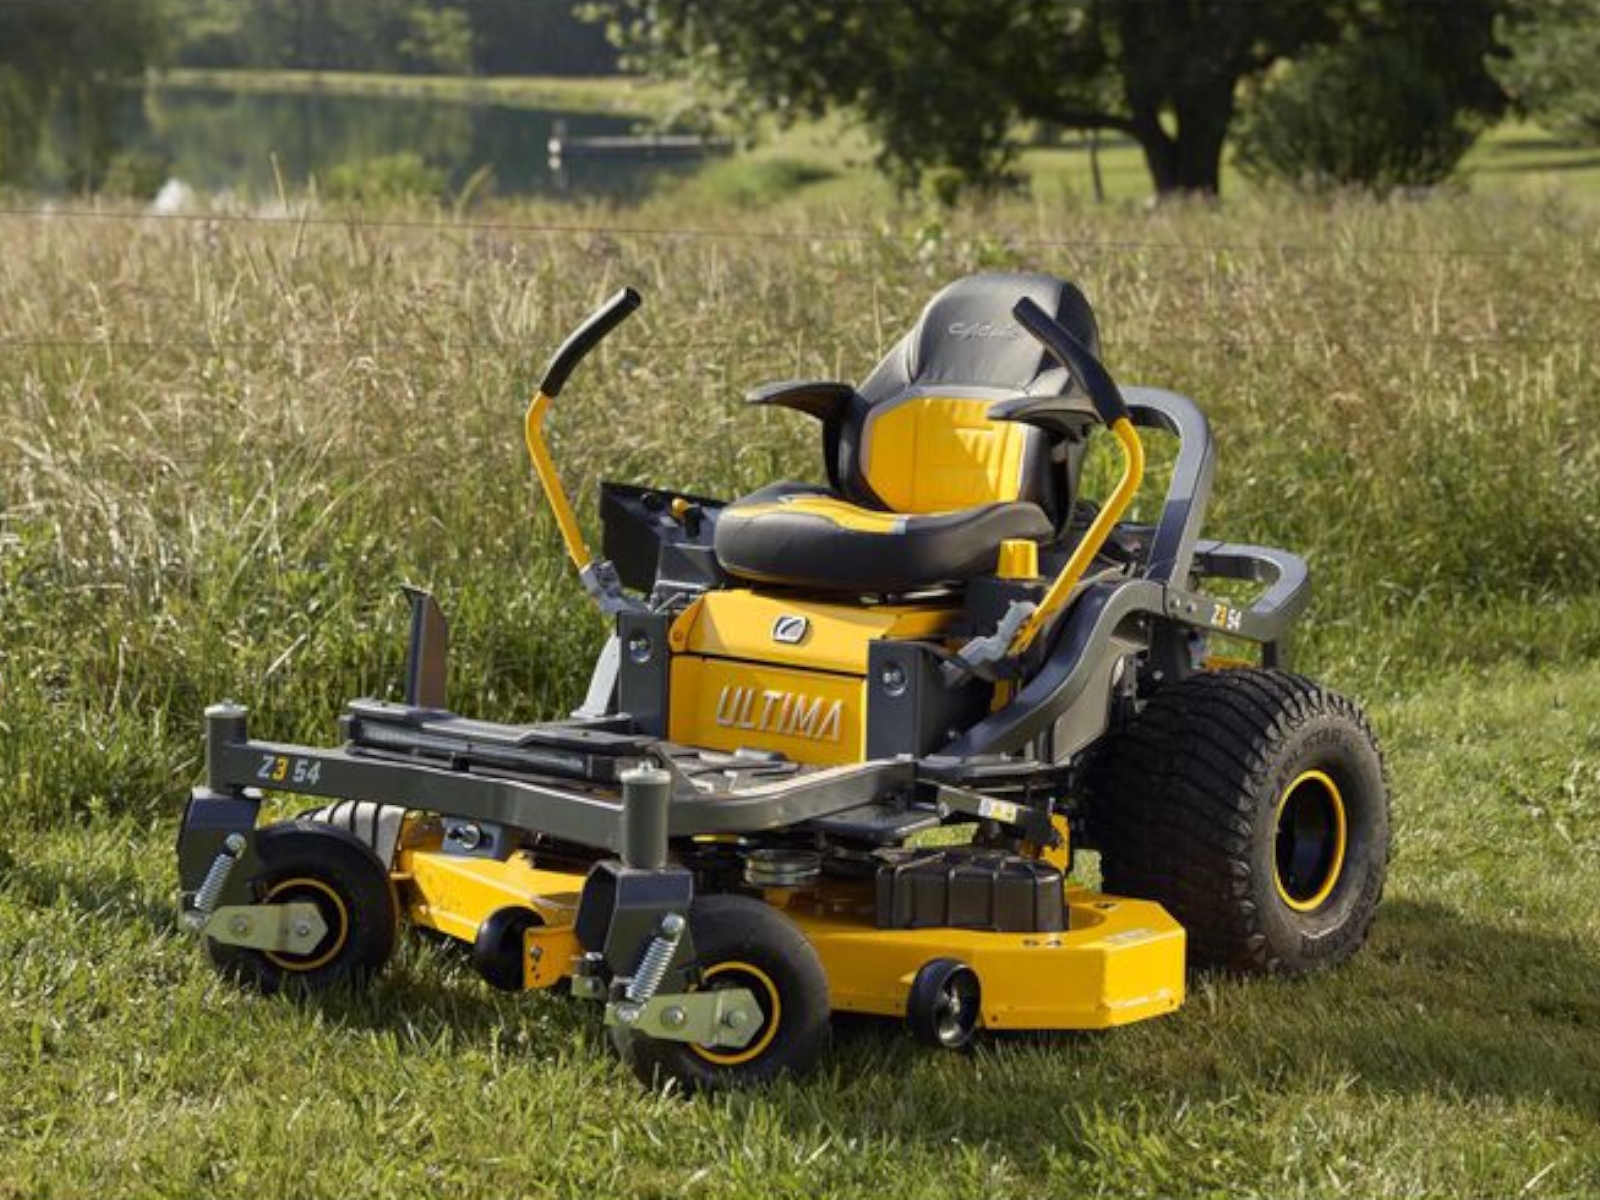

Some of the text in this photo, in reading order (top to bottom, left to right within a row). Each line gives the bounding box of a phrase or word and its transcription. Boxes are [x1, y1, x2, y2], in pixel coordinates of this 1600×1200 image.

[716, 685, 843, 743] ULTIMA
[257, 753, 322, 785] Z3 54
